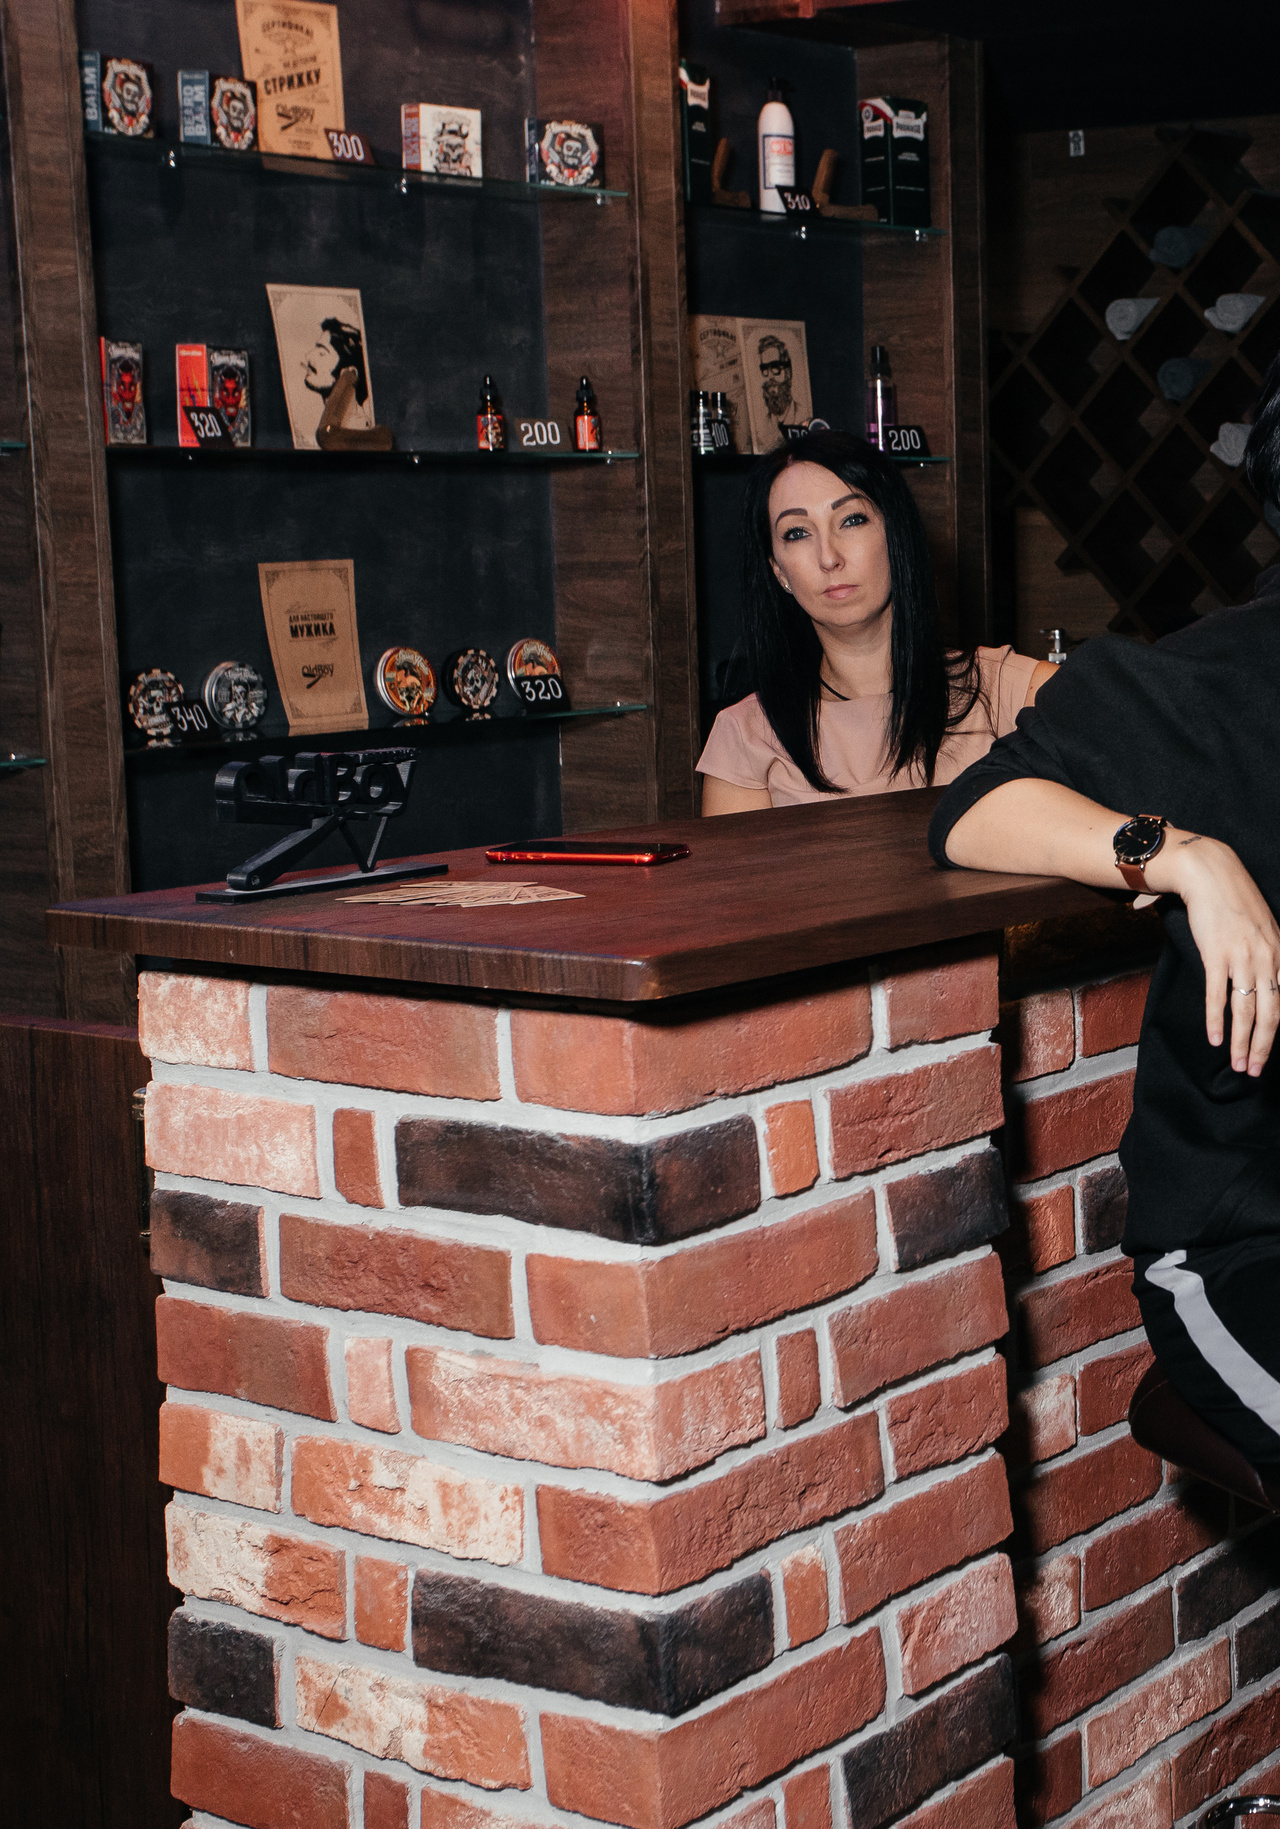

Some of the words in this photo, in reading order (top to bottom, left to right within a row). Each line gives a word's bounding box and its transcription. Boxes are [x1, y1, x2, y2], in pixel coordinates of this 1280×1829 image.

[84, 66, 98, 120] BALM
[264, 68, 321, 95] СТРИЖКУ
[329, 131, 365, 161] 300
[190, 411, 222, 439] 320
[520, 421, 561, 446] 200
[711, 422, 729, 447] 100
[889, 429, 921, 451] 200
[290, 622, 336, 638] МУЖИКА
[520, 677, 563, 702] 320
[171, 704, 209, 732] 340
